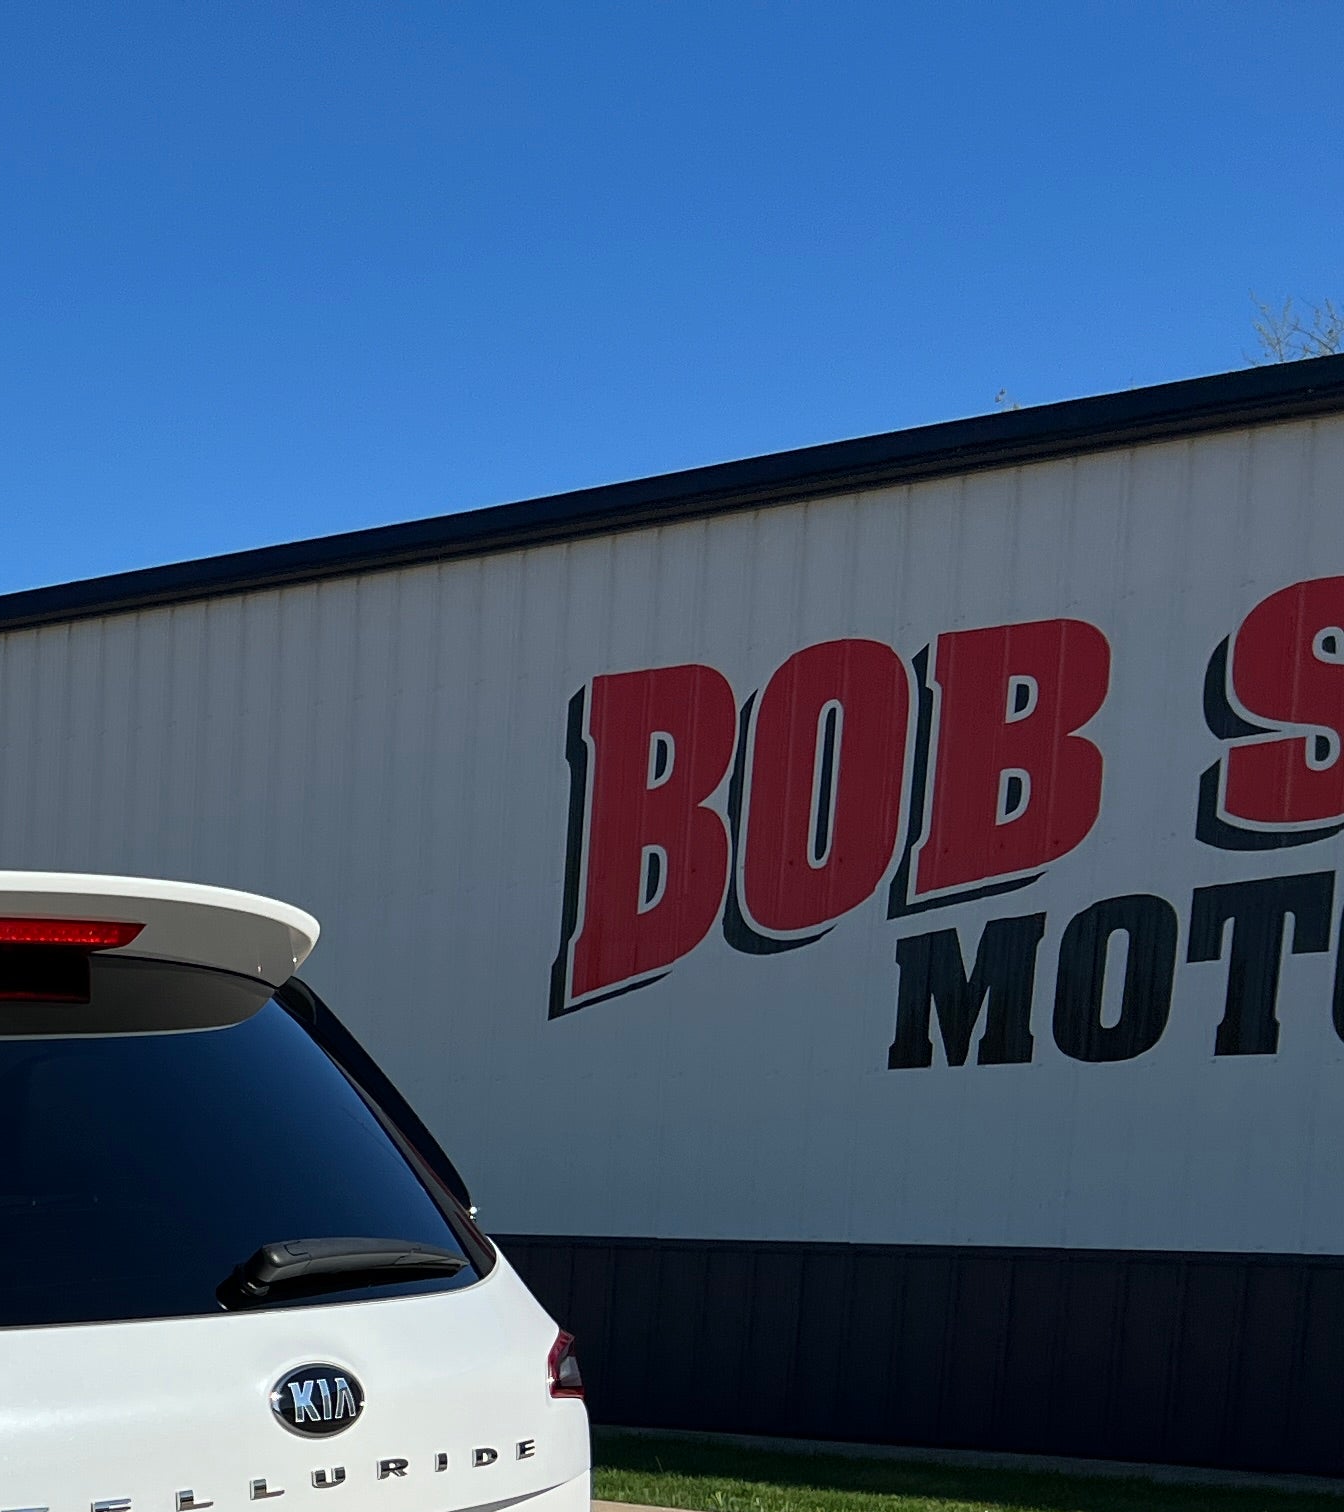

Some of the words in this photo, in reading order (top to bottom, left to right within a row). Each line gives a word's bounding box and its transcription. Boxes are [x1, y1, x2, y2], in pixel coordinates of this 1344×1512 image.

[548, 617, 1111, 1020] BOB
[887, 870, 1344, 1070] MOT
[286, 1376, 358, 1423] KIA
